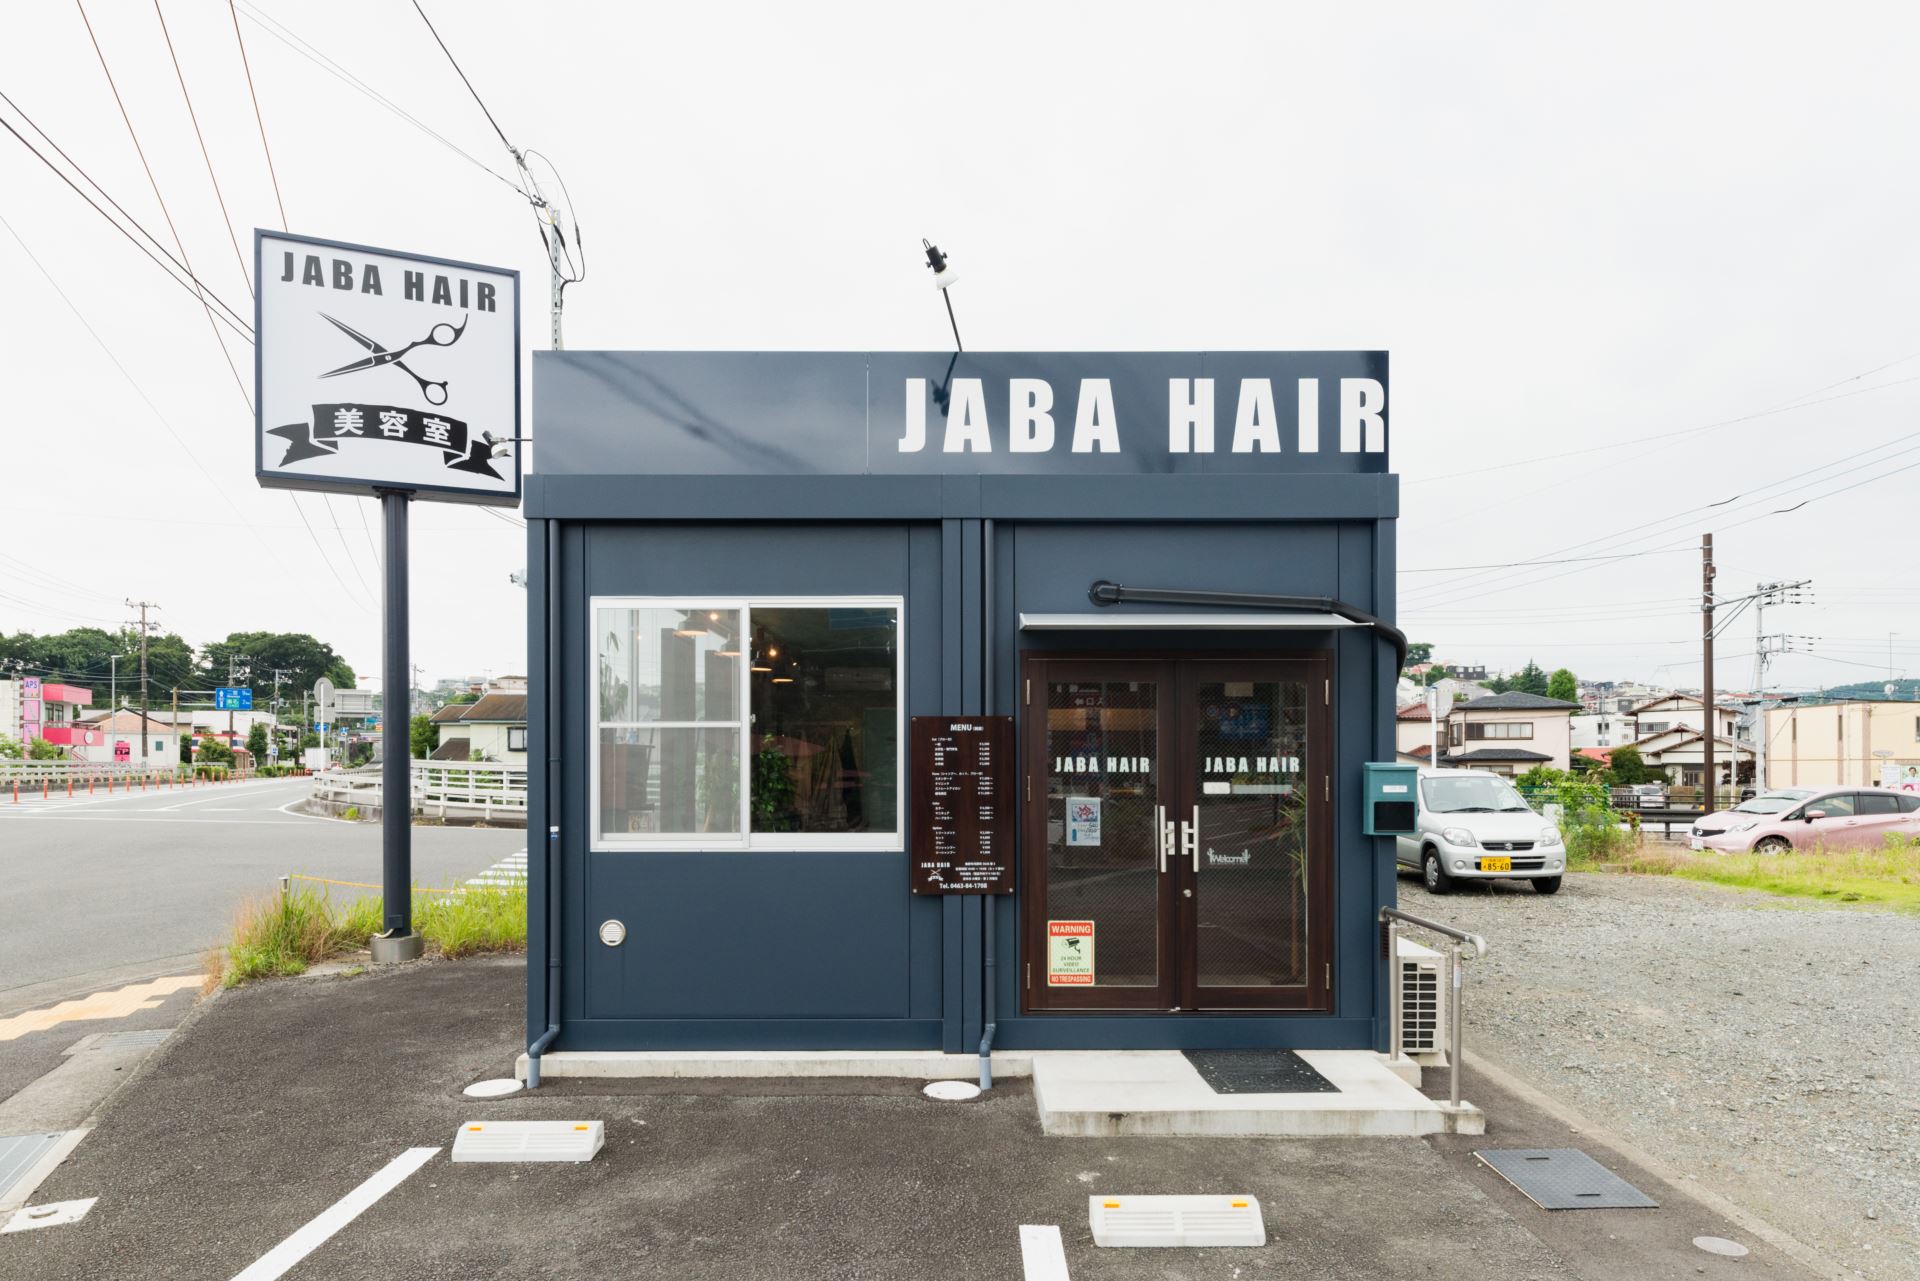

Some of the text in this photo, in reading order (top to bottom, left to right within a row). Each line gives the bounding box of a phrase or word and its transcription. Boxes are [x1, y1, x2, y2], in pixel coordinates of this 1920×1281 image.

[281, 251, 497, 313] JABA HAIR
[898, 377, 1385, 454] JABA HAIR
[333, 407, 452, 447] 美容室
[25, 681, 38, 689] APS
[950, 723, 973, 732] MENU
[1055, 757, 1150, 773] JABA HAIR
[1205, 757, 1300, 773] JABA HAIR
[1210, 853, 1247, 864] Welcome
[1487, 862, 1510, 871] 85-60
[1051, 925, 1091, 933] WARNING
